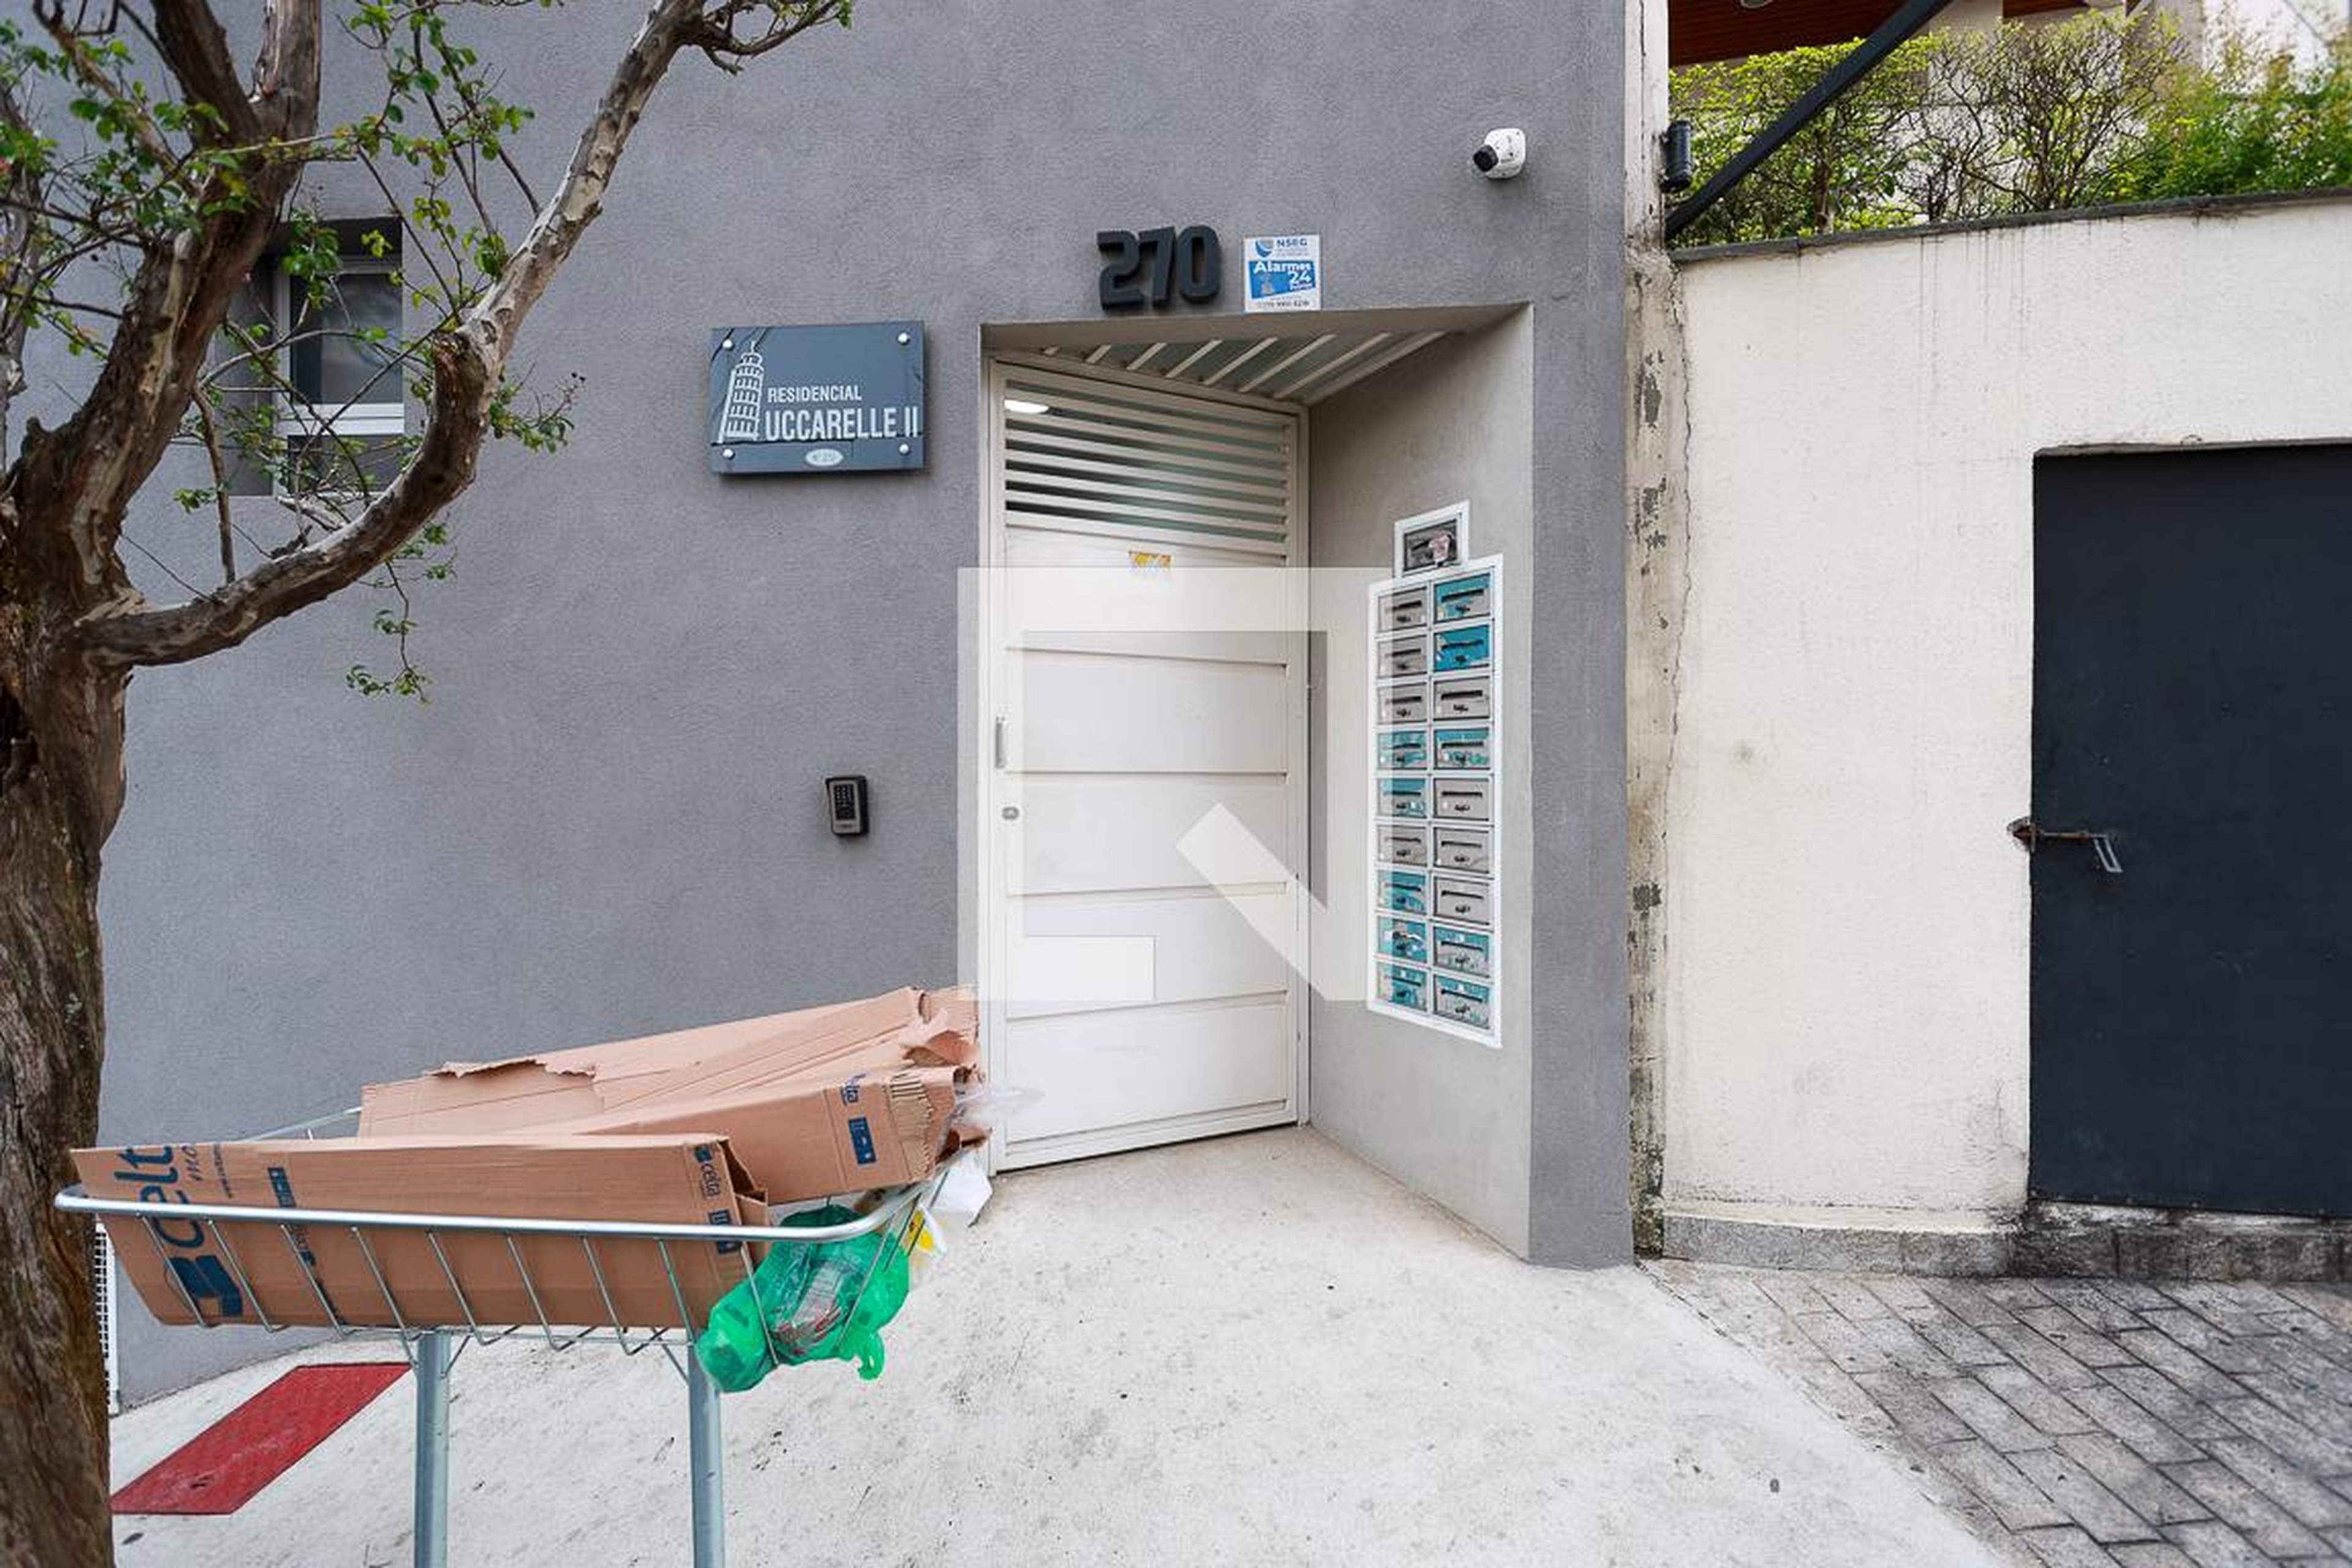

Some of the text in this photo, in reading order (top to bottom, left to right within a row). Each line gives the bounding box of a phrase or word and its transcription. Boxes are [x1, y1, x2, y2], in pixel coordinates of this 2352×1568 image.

[1097, 225, 1223, 310] 270
[1288, 270, 1312, 283] 24
[767, 385, 862, 402] RESIDENCIAL
[904, 406, 918, 437] II
